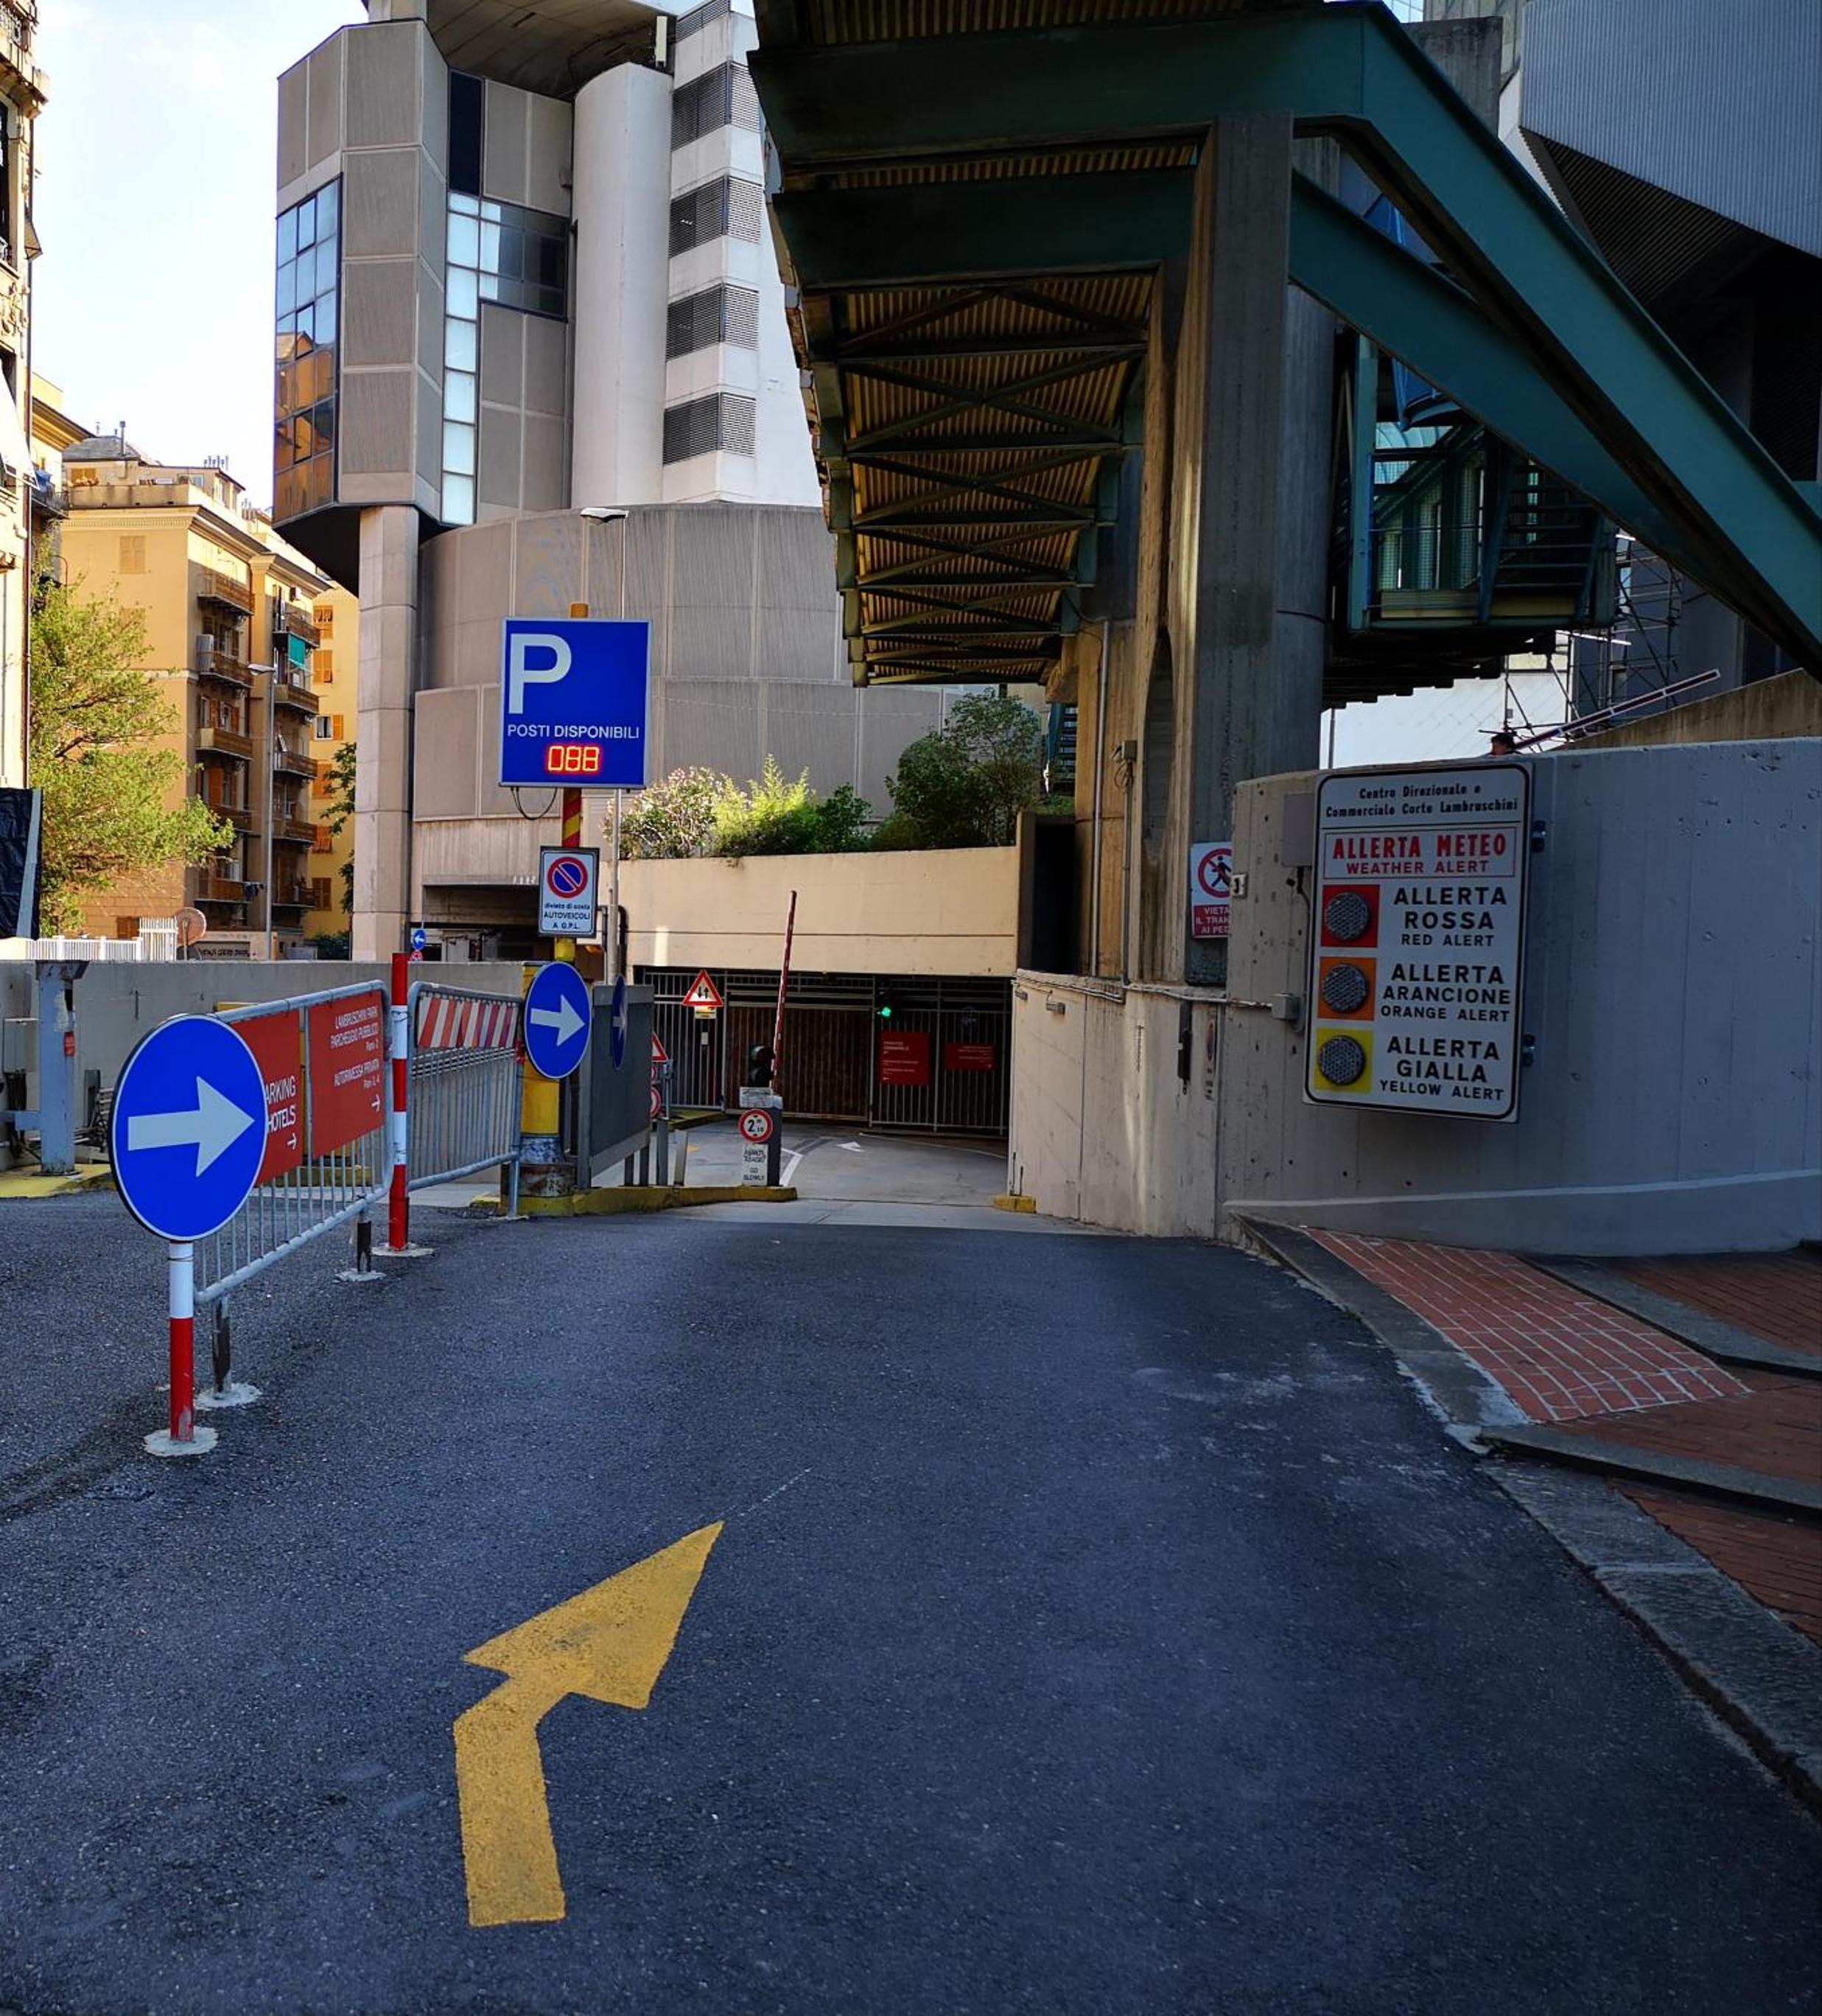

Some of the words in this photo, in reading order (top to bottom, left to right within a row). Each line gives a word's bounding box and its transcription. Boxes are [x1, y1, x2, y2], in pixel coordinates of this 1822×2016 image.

[508, 633, 572, 715] P
[508, 724, 550, 737] POSTI
[555, 725, 640, 738] DISPONIBILI
[1359, 788, 1395, 799] Centro
[1403, 783, 1467, 797] Direzionale
[1474, 785, 1481, 794] e
[1326, 804, 1395, 818] Commerciale
[1402, 802, 1432, 814] Corte
[1440, 798, 1518, 813] Lambruschini
[1333, 836, 1421, 859] ALLERTA
[1437, 833, 1506, 857] METEO
[1347, 862, 1424, 875] WEATHER
[1434, 860, 1490, 872] ALERT
[1393, 886, 1507, 906] ALLERTA
[544, 911, 590, 920] AUTOVEICOLI
[1405, 911, 1494, 929] ROSSA
[1401, 934, 1432, 945] RED
[1443, 934, 1494, 947] ALERT
[1391, 963, 1504, 984] ALLERTA
[1383, 985, 1511, 1004] ARANCIONE
[1381, 1005, 1447, 1019] ORANGE
[1457, 1009, 1510, 1022] ALERT
[1387, 1036, 1500, 1060] ALLERTA
[1397, 1060, 1487, 1083] GIALLA
[1380, 1079, 1442, 1096] YELLOW
[1451, 1085, 1504, 1101] ALERT
